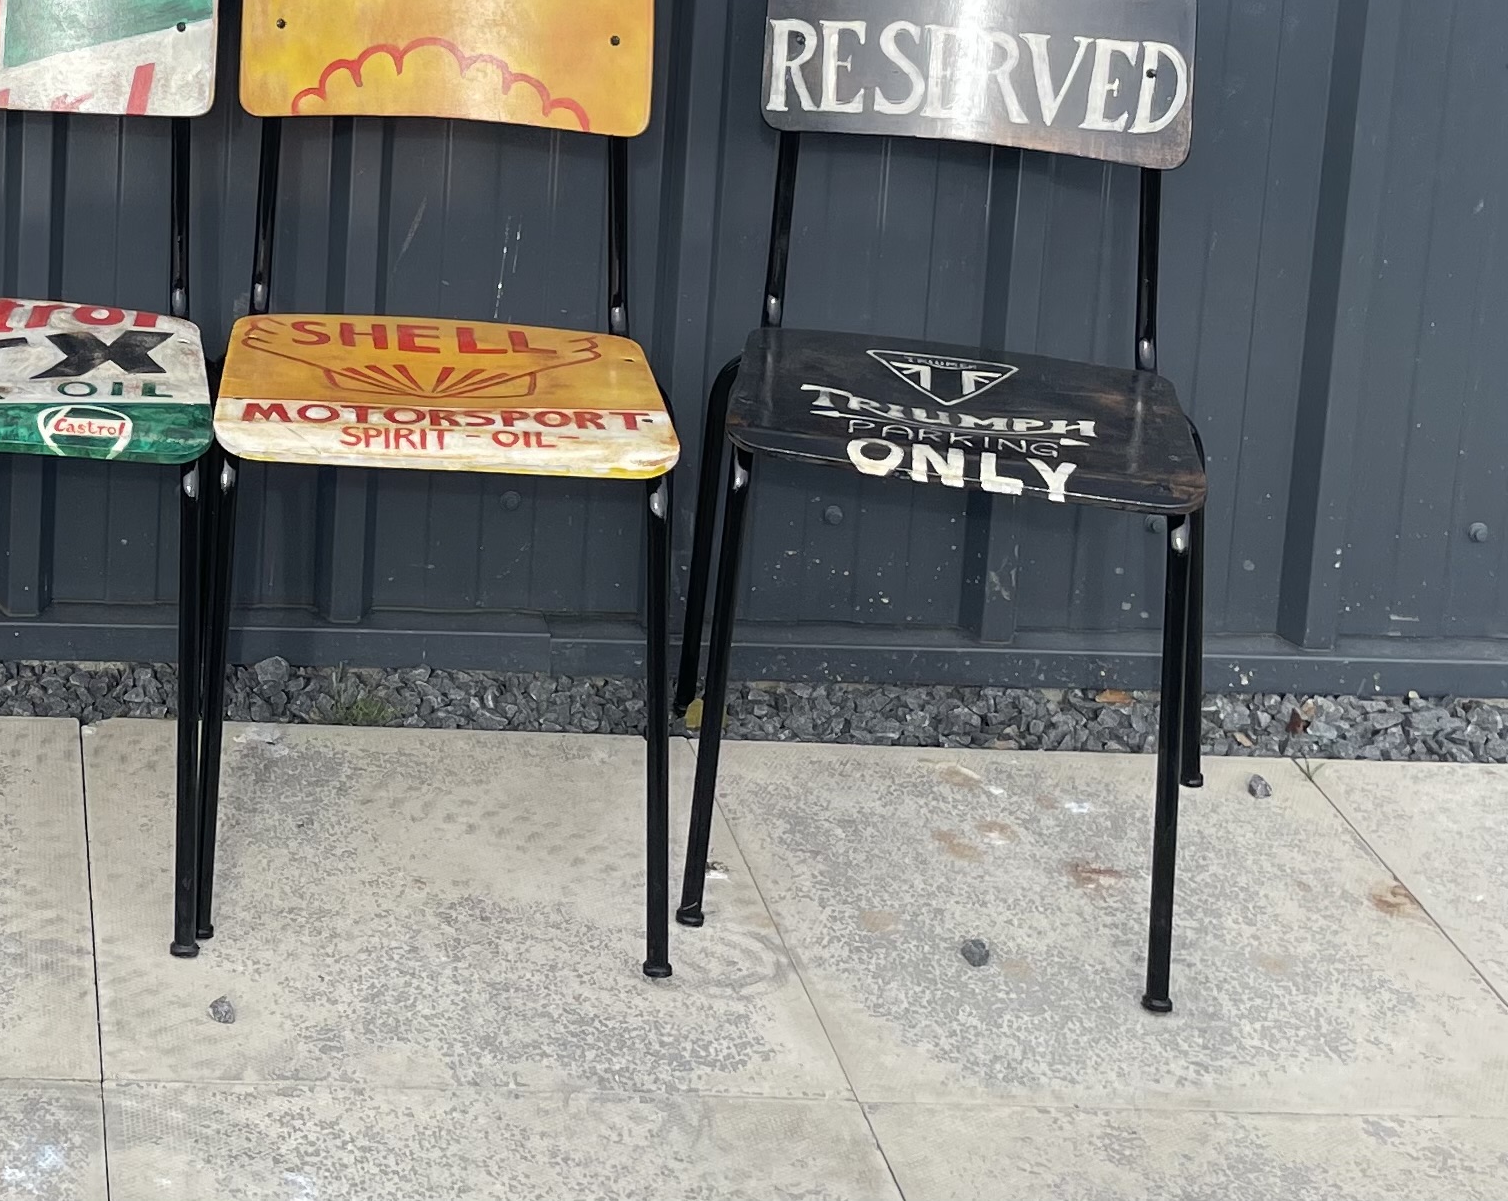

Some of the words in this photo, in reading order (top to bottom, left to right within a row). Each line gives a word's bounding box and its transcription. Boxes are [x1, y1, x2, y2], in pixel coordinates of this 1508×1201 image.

[766, 17, 1188, 135] RESERVED
[291, 320, 557, 355] SHELL
[57, 381, 174, 399] OIL
[54, 418, 125, 437] Castrol
[241, 403, 653, 431] MOTORSPORT
[800, 383, 1098, 439] TRIUMPH
[340, 426, 454, 450] SPIRIT
[491, 430, 557, 449] OIL
[847, 419, 1059, 458] PARKING
[846, 438, 1078, 503] ONLY
